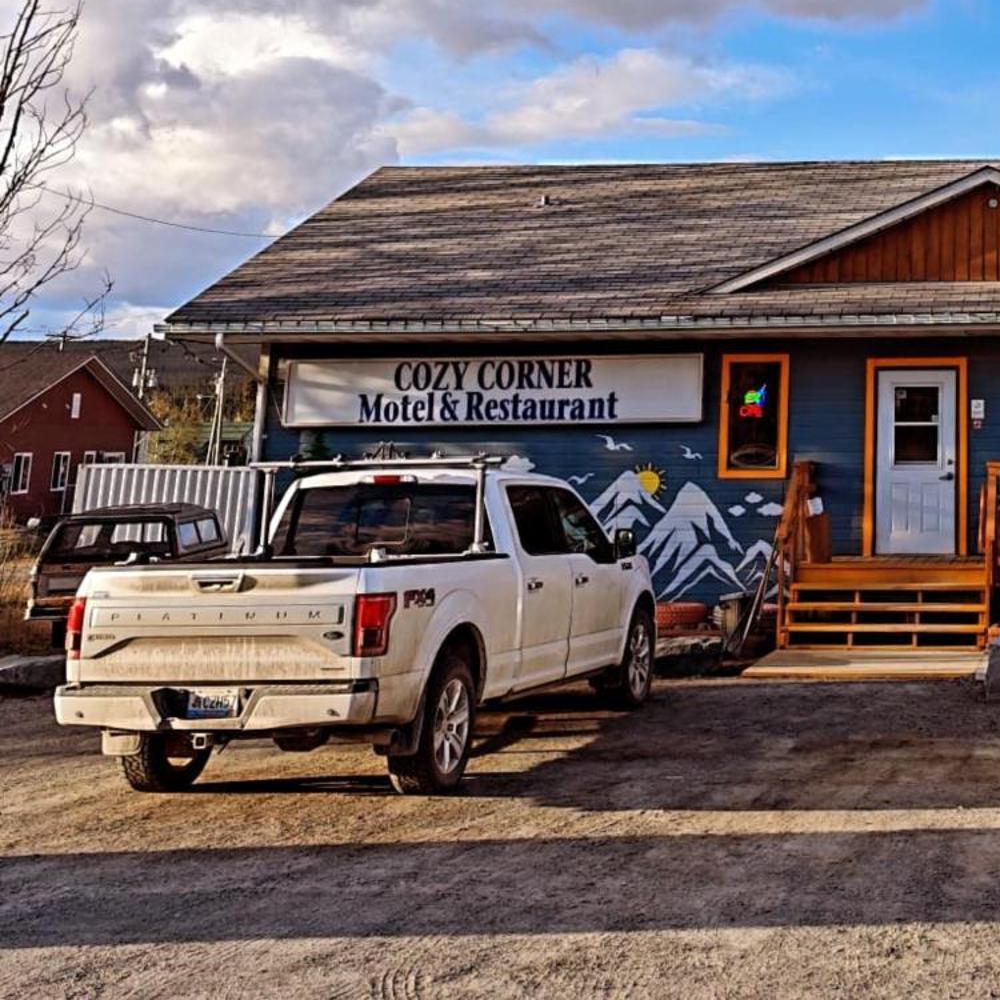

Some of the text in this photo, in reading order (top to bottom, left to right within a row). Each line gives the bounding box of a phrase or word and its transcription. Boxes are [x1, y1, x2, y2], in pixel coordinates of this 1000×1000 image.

[394, 359, 593, 391] COZY CORNER
[358, 390, 619, 423] Motel & Restaurant
[110, 610, 322, 622] PLATINUM
